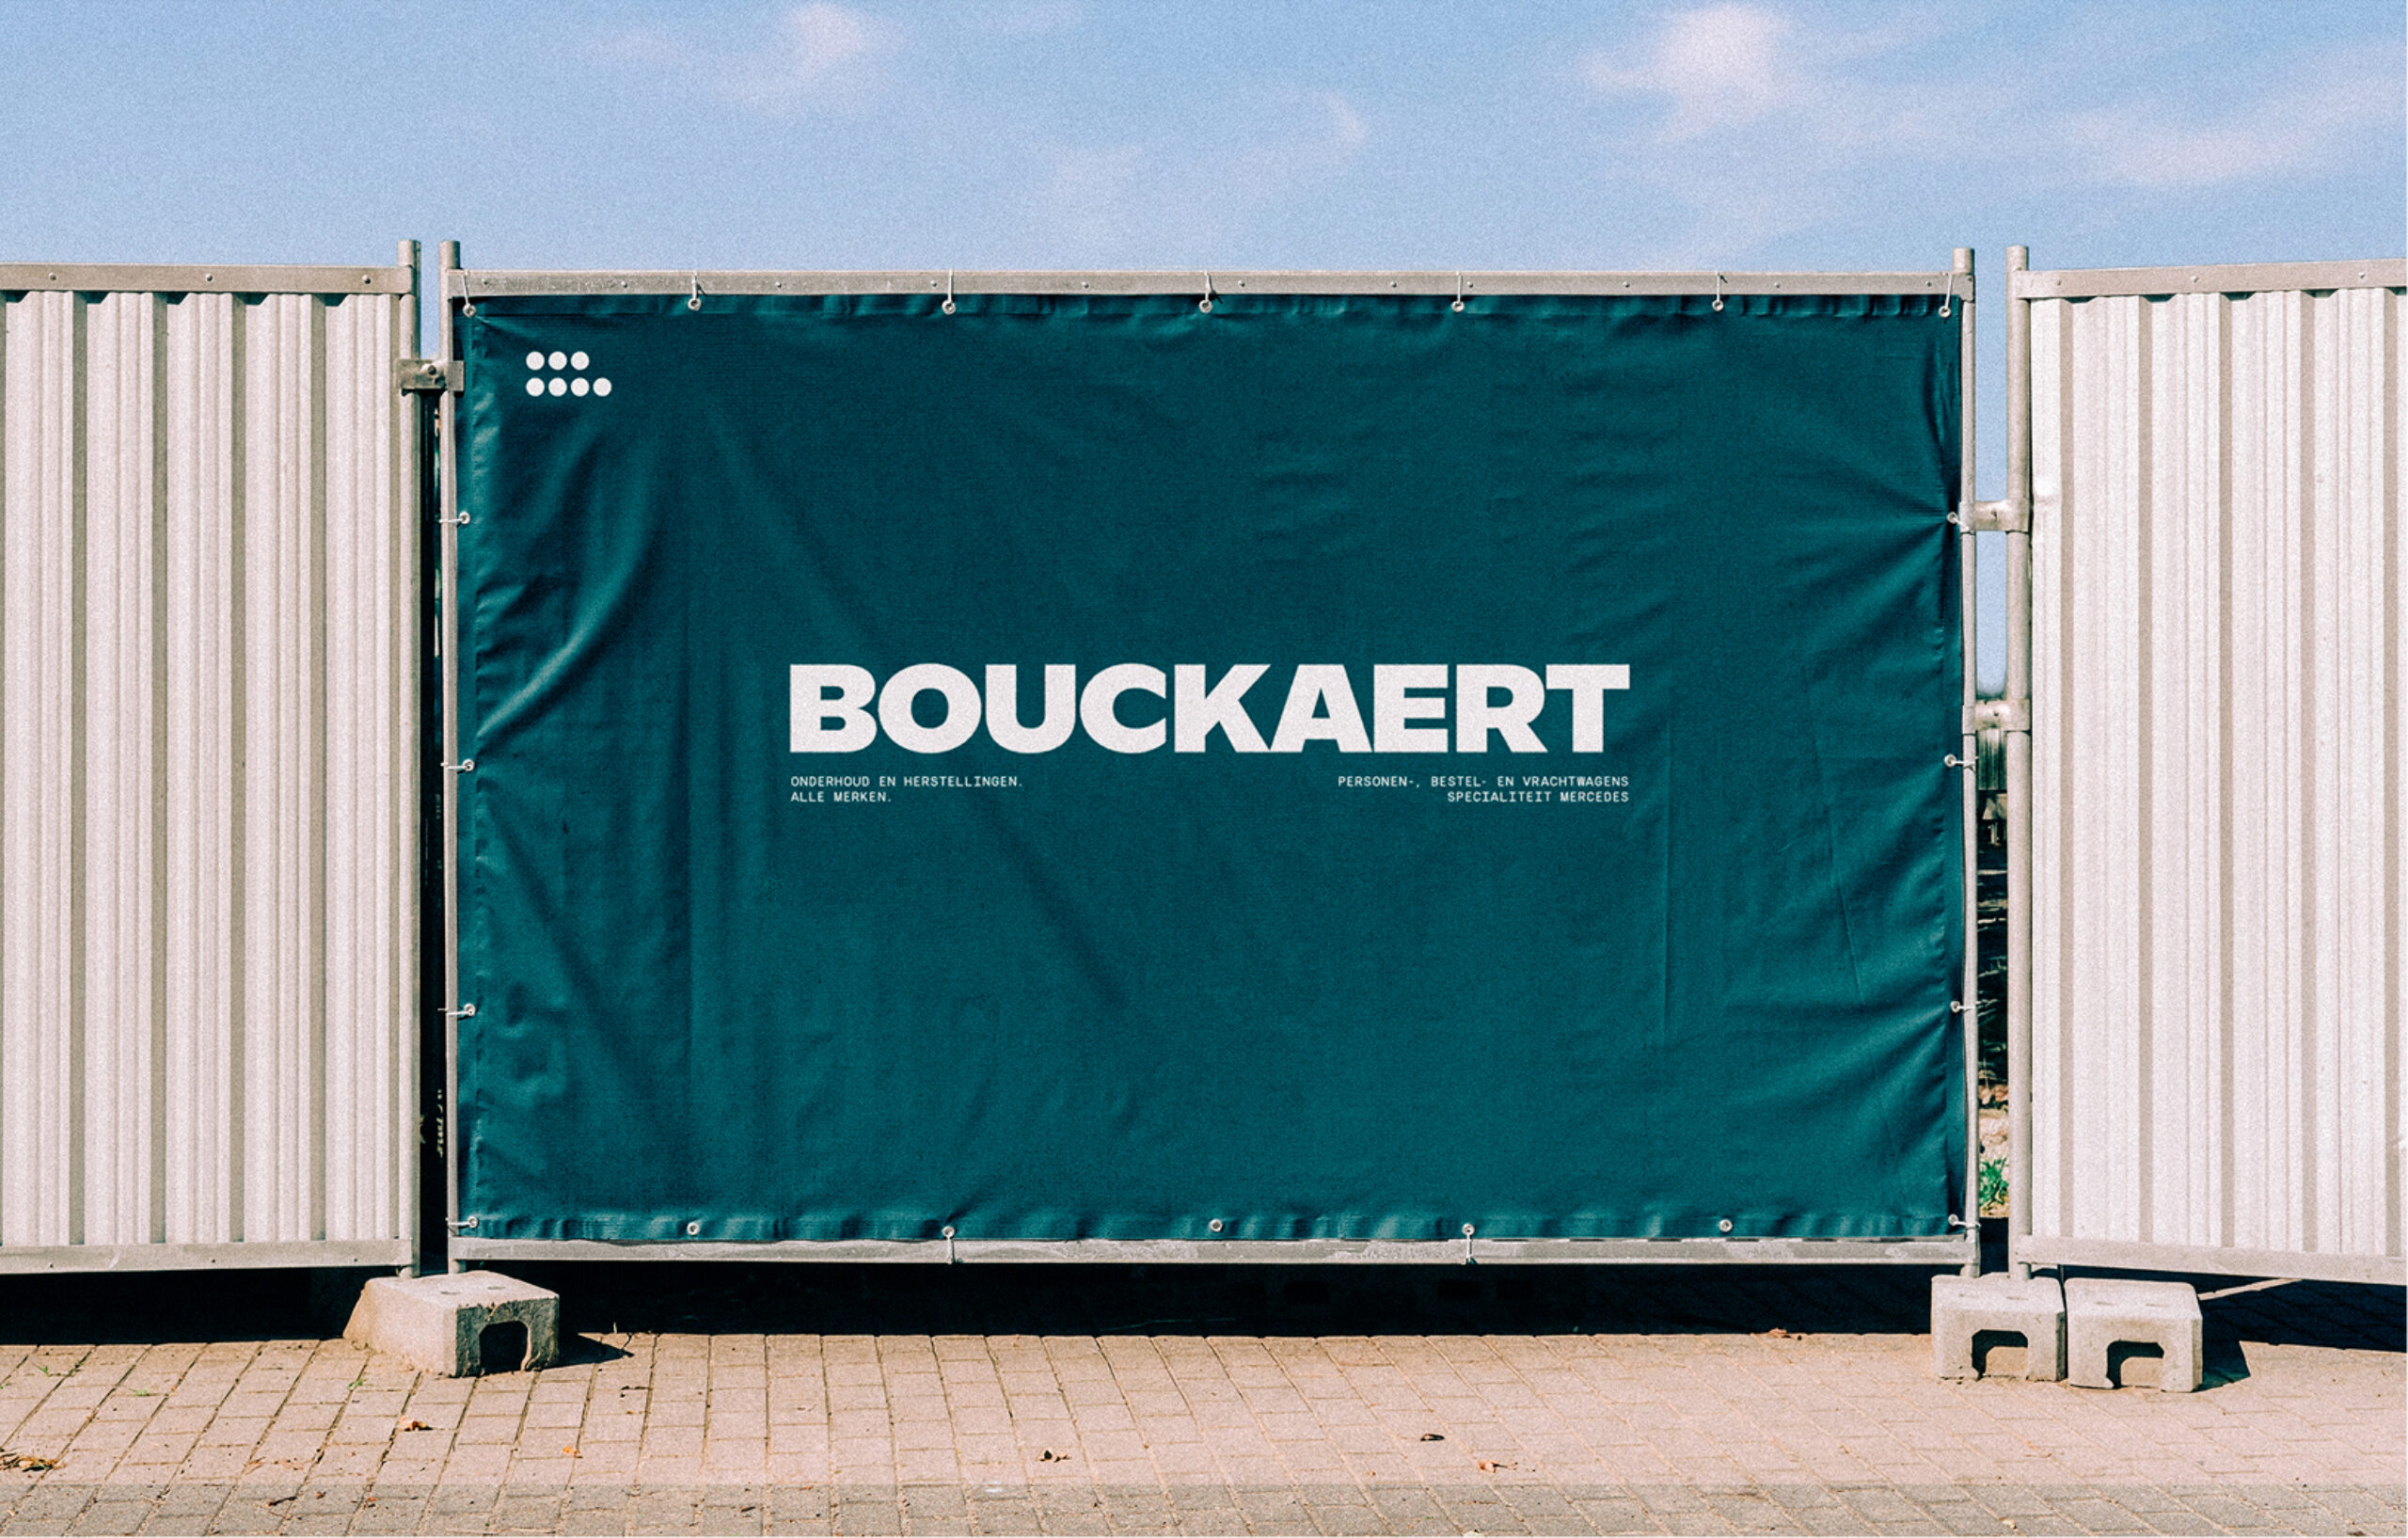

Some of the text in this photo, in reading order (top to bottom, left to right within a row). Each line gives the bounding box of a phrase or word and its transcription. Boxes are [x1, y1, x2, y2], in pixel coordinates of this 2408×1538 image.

[790, 664, 1630, 753] BOUCKAERT
[790, 776, 1022, 787] ONDERHOUD EN HERSTELLINGEN.
[1338, 776, 1629, 788] PERSONEN-, BESTEL- EN VRACHTWAGENS
[790, 791, 892, 802] ALLE MERKEN.
[1447, 791, 1629, 802] SPECIALITEIT MERCEDES
